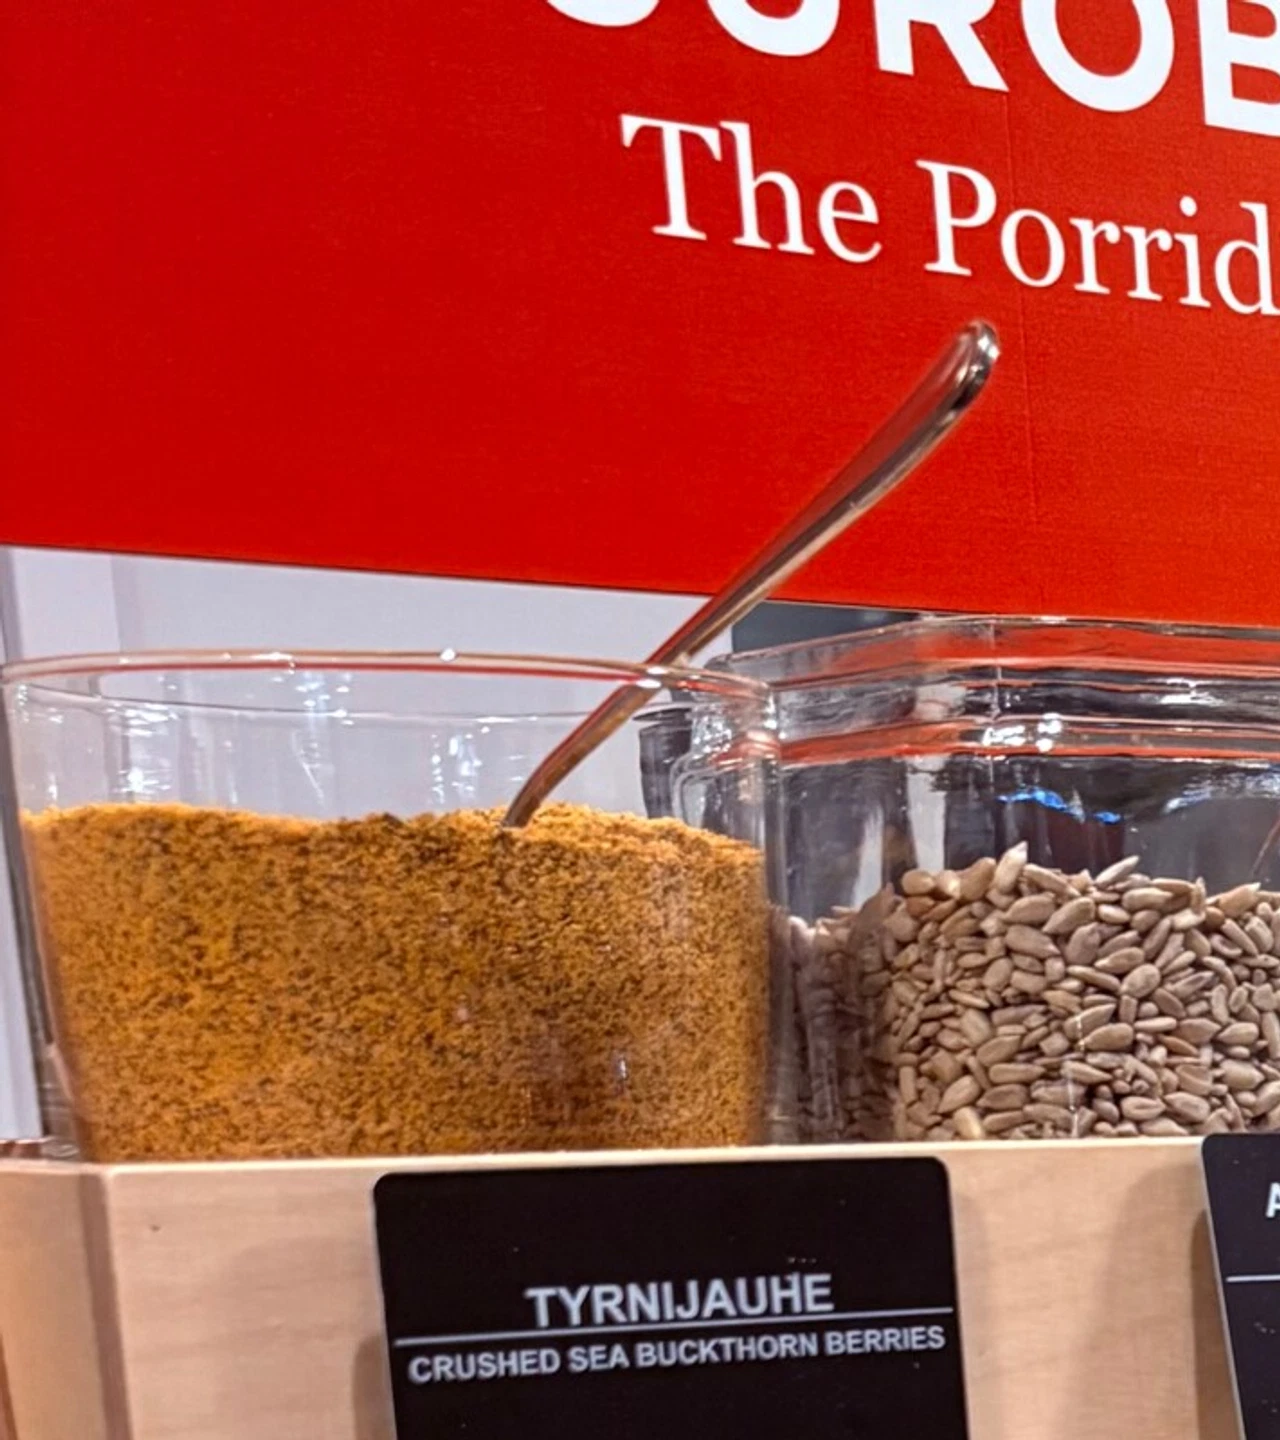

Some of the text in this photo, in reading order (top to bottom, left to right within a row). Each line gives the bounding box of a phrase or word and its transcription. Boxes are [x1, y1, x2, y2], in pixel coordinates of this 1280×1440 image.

[620, 113, 882, 264] The
[525, 1272, 834, 1328] TYRNIJAUHE
[408, 1325, 946, 1383] CRUSHED SEA BUCKTHORN BERRIES
